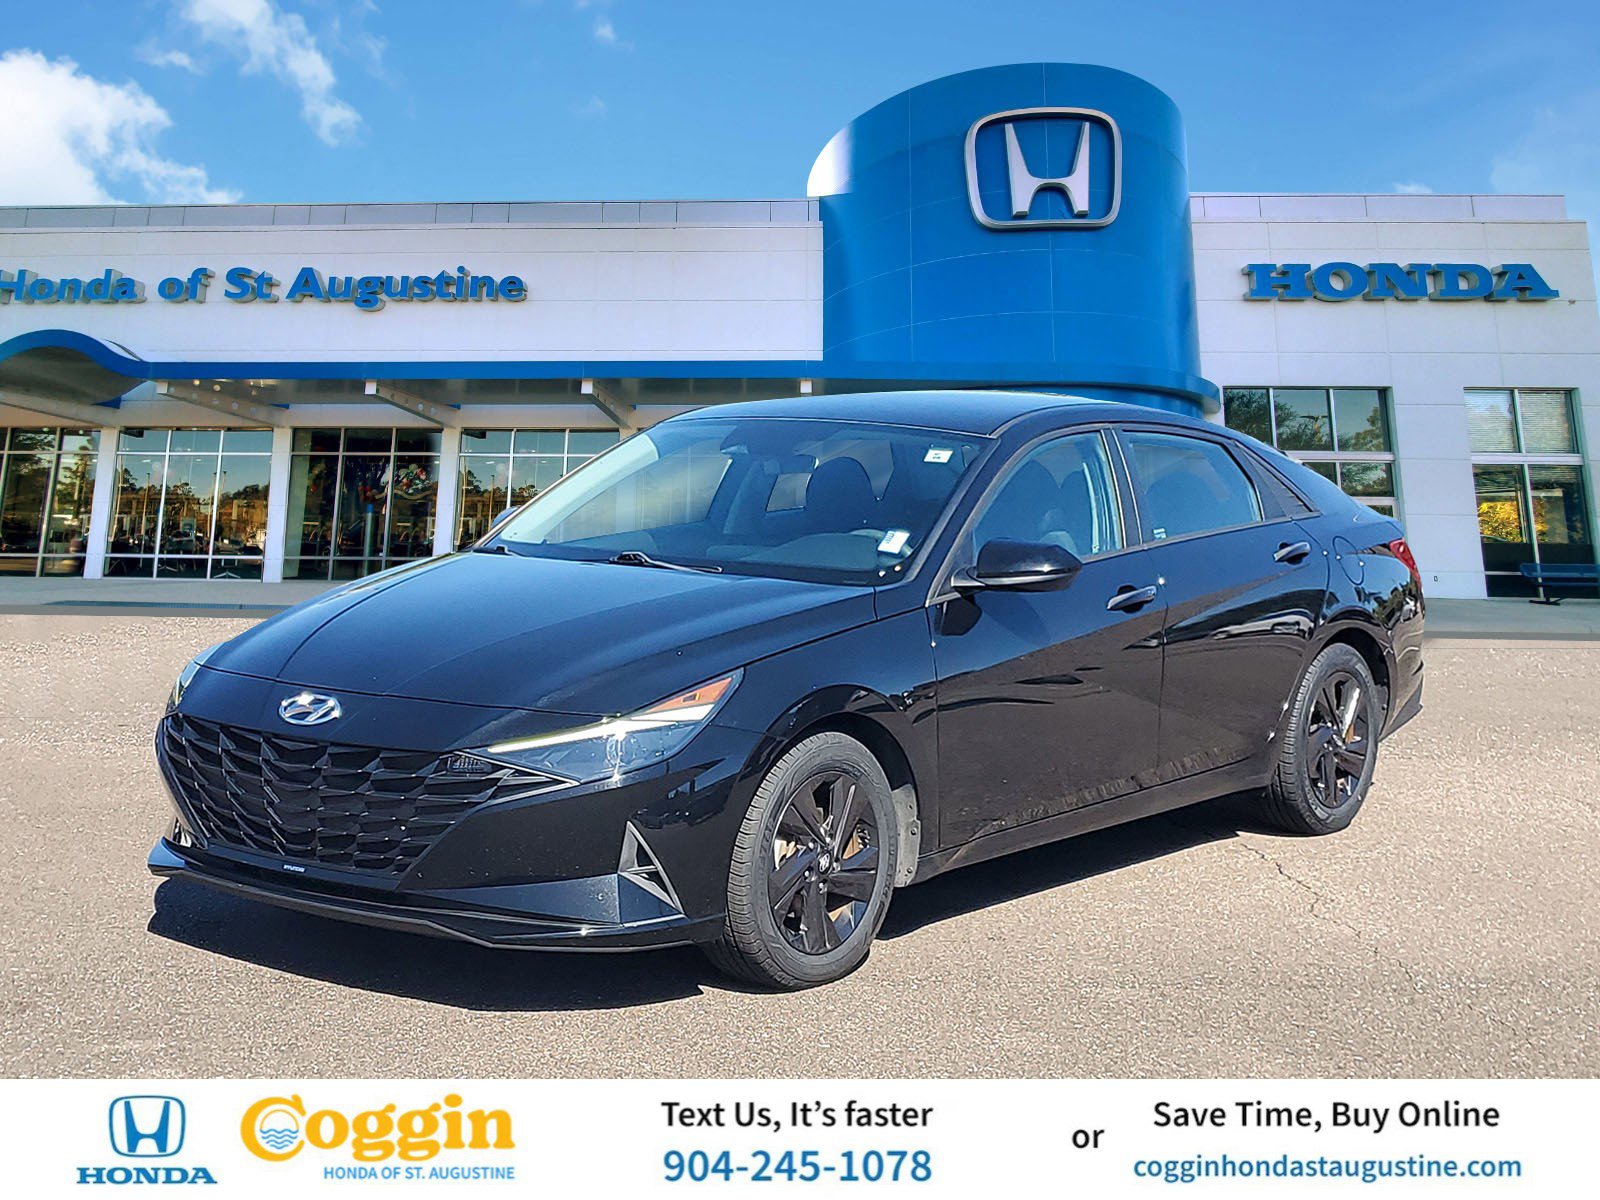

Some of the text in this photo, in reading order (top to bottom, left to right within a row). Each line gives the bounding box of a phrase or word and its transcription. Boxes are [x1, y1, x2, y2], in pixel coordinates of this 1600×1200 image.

[0, 265, 528, 312] Honda of St Augustine
[1242, 261, 1560, 302] HONDA
